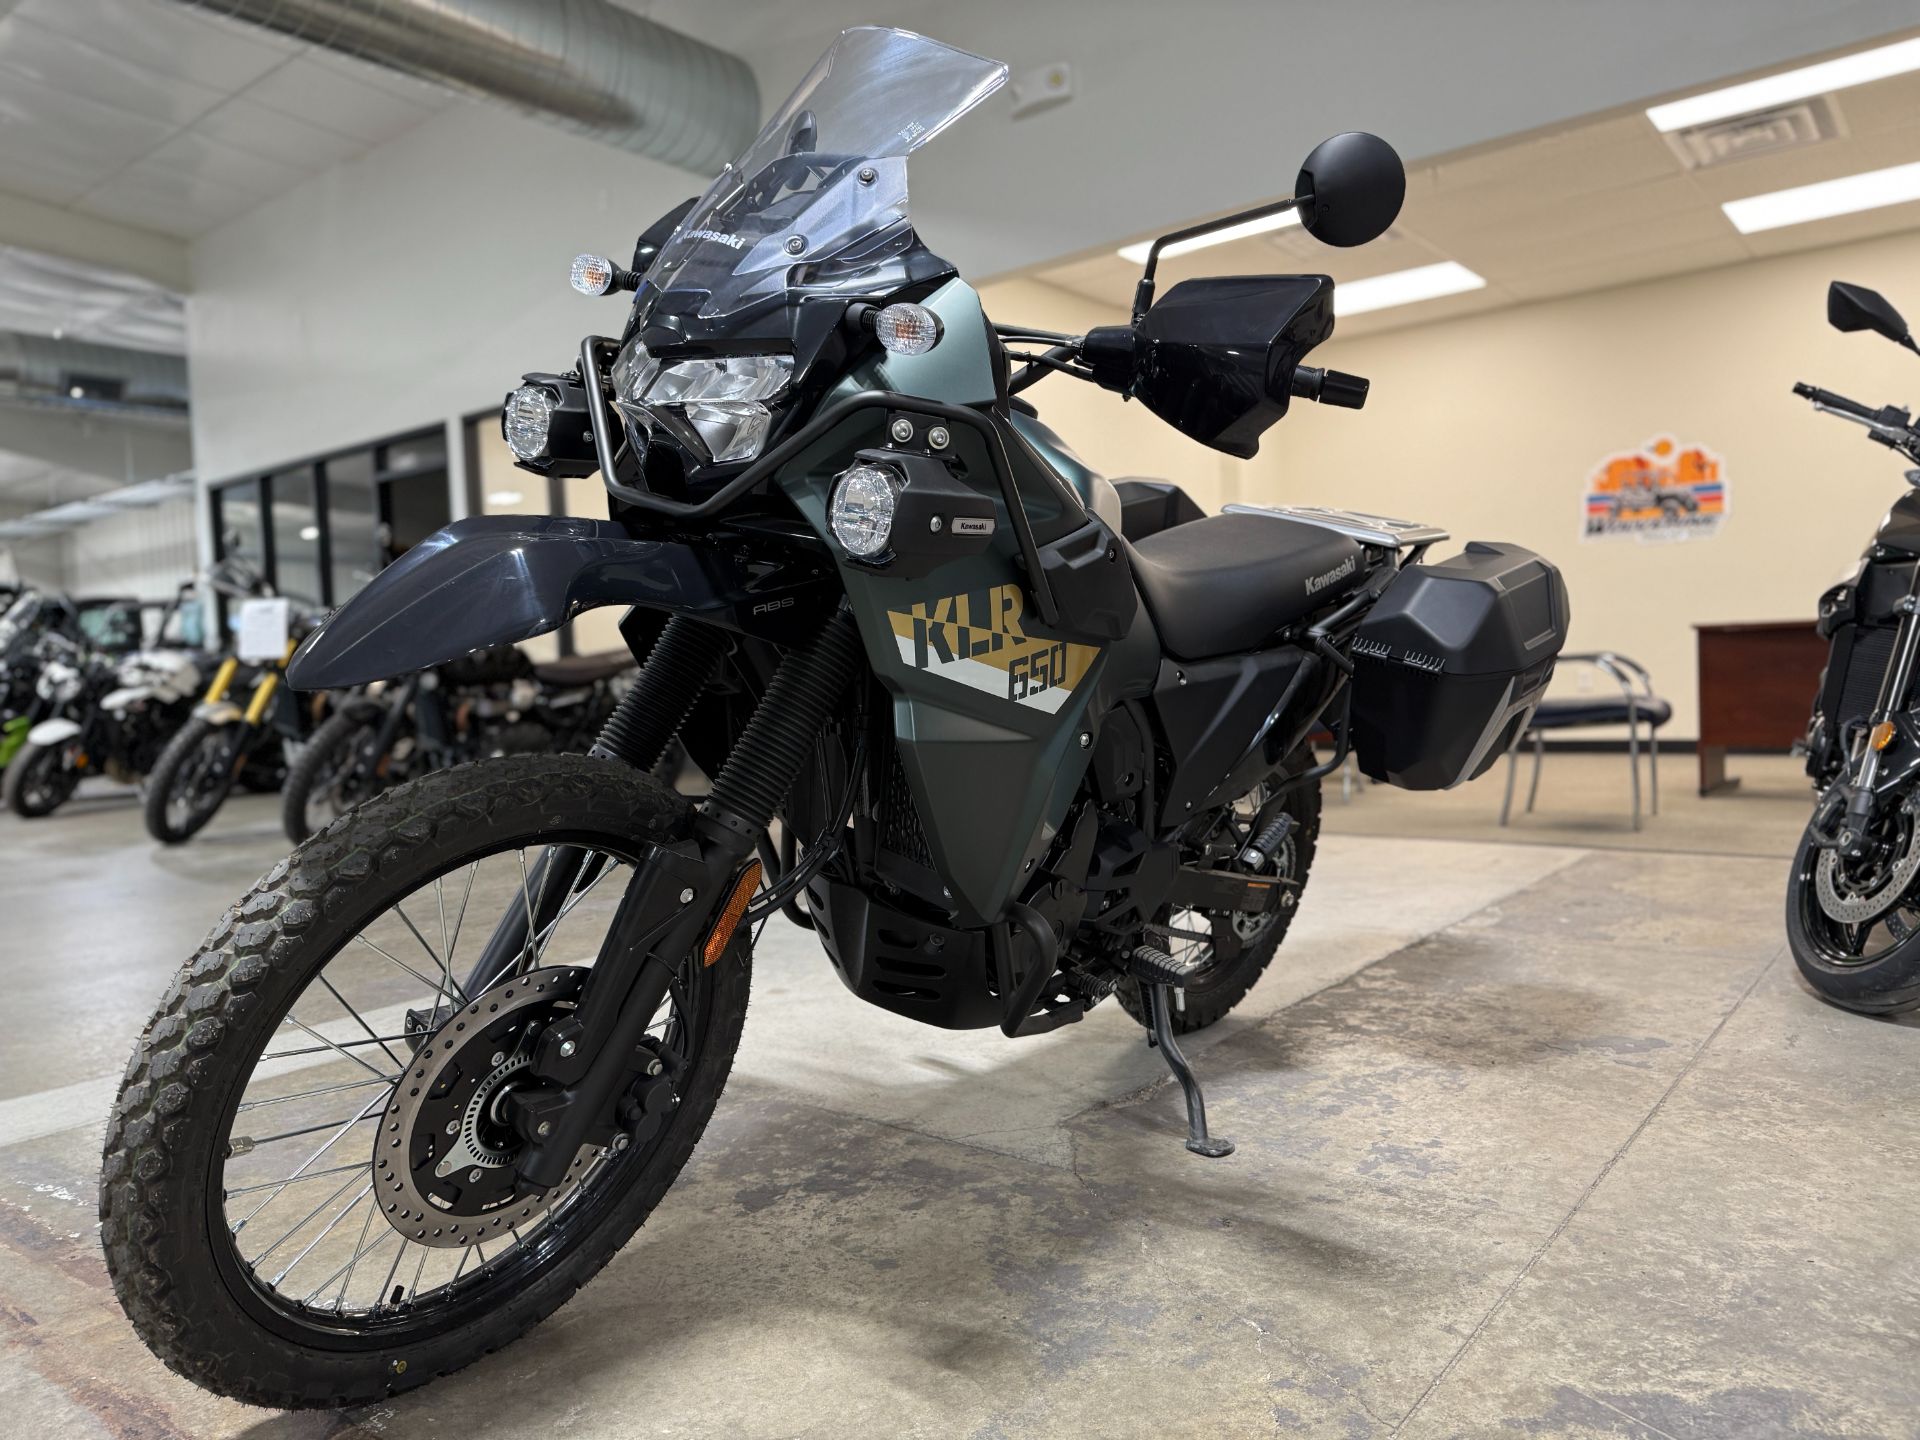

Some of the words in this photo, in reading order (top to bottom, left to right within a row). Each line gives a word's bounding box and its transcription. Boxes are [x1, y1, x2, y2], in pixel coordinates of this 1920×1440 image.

[960, 522, 987, 530] Kawasaki
[1305, 555, 1356, 596] Kawasaki
[753, 597, 794, 616] ABS
[911, 583, 1028, 669] KLR
[1008, 641, 1067, 701] 650
